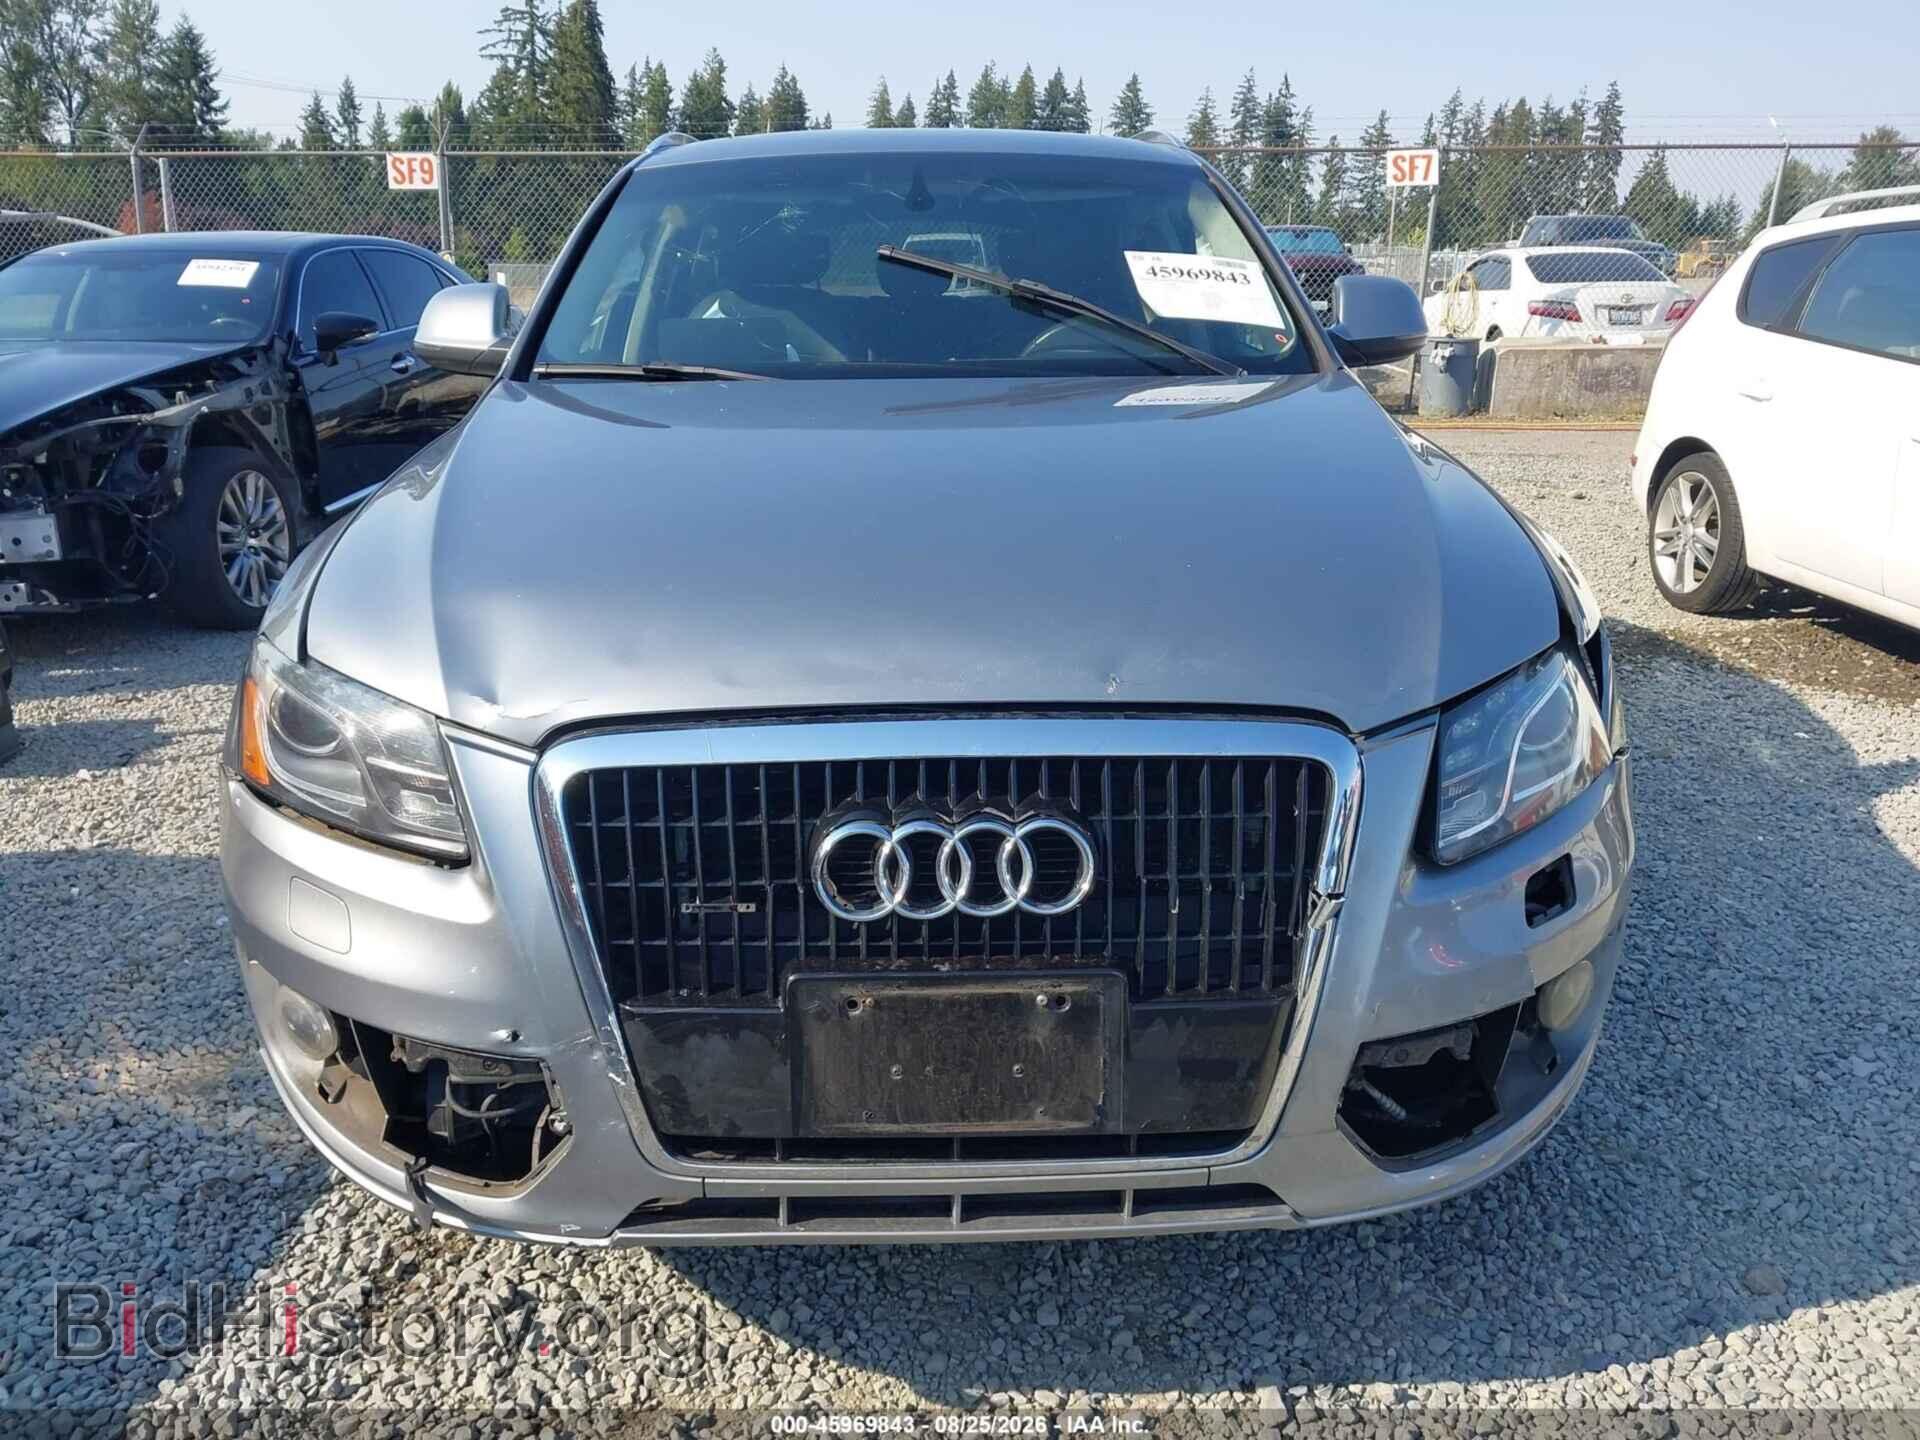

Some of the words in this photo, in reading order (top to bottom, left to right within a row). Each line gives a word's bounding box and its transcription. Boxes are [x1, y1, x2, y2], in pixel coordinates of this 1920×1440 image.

[391, 156, 434, 185] SF9
[1392, 155, 1433, 182] SF7
[1145, 265, 1251, 285] 45969843
